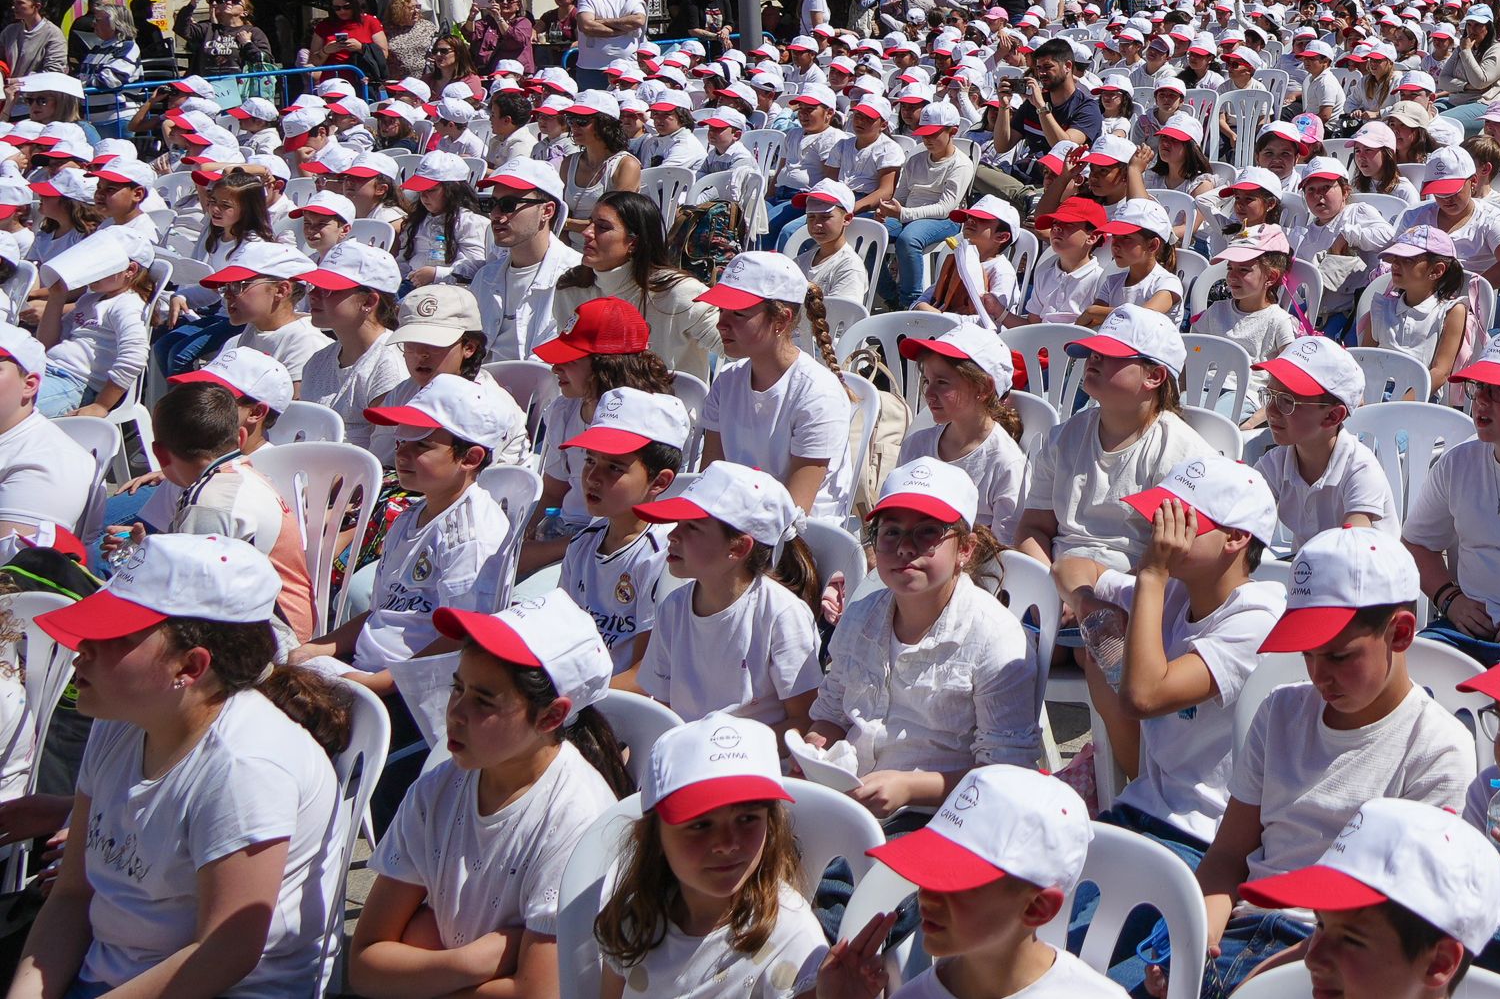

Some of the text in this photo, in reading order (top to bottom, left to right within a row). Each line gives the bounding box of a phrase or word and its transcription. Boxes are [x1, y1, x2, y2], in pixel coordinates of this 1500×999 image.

[1398, 104, 1406, 114] A
[416, 295, 438, 318] G
[1291, 349, 1310, 363] CAYMA
[599, 412, 619, 421] CAYMA
[902, 480, 931, 489] CAYMA
[1174, 474, 1196, 491] CAYMA
[709, 751, 749, 763] CAYMA
[940, 808, 965, 828] CAYMA
